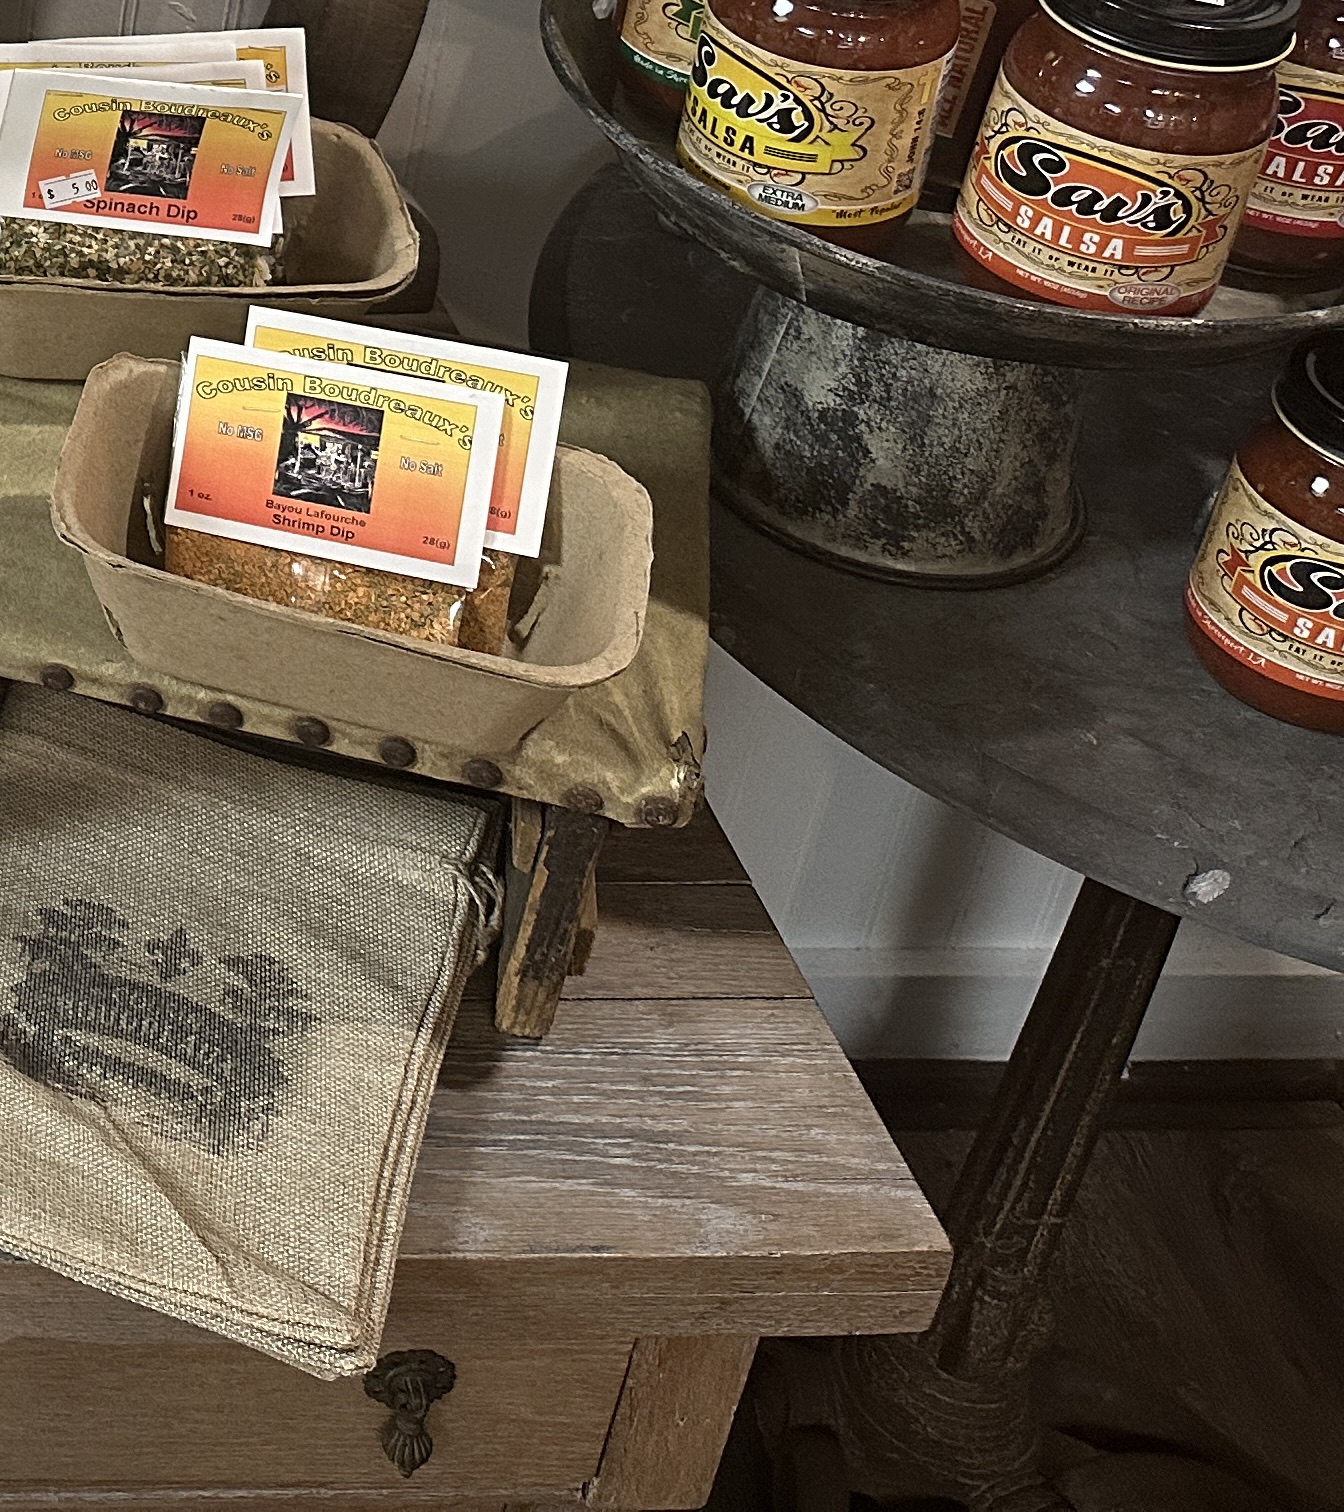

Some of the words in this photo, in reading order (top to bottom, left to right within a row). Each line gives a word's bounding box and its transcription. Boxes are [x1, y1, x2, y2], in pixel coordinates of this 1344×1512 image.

[690, 31, 810, 140] Sav's
[53, 99, 132, 123] Cousin
[139, 99, 273, 142] Boudreaux's
[689, 97, 755, 158] SALSA
[46, 188, 56, 201] $
[71, 181, 81, 196] 5
[85, 178, 99, 193] 00
[761, 184, 805, 204] EXTRA
[997, 138, 1187, 233] Sav's
[82, 199, 160, 218] Spinach
[166, 203, 199, 223] Dip
[757, 193, 806, 212] MEDIUM
[1016, 204, 1125, 261] SALSA
[1010, 235, 1028, 251] EAT
[1066, 259, 1099, 275] WEAR
[1116, 284, 1177, 299] ORIGINAL
[1121, 295, 1168, 307] RECIPE
[363, 347, 535, 421] Boudreaux's
[196, 373, 293, 399] Cousin
[303, 377, 473, 451] Boudreaux's
[218, 422, 234, 436] No
[400, 456, 417, 472] No
[265, 498, 302, 517] Bayou
[305, 506, 367, 529] Lafourche
[271, 512, 324, 537] Shrimp
[329, 524, 356, 542] Dip
[1288, 643, 1307, 656] EAT
